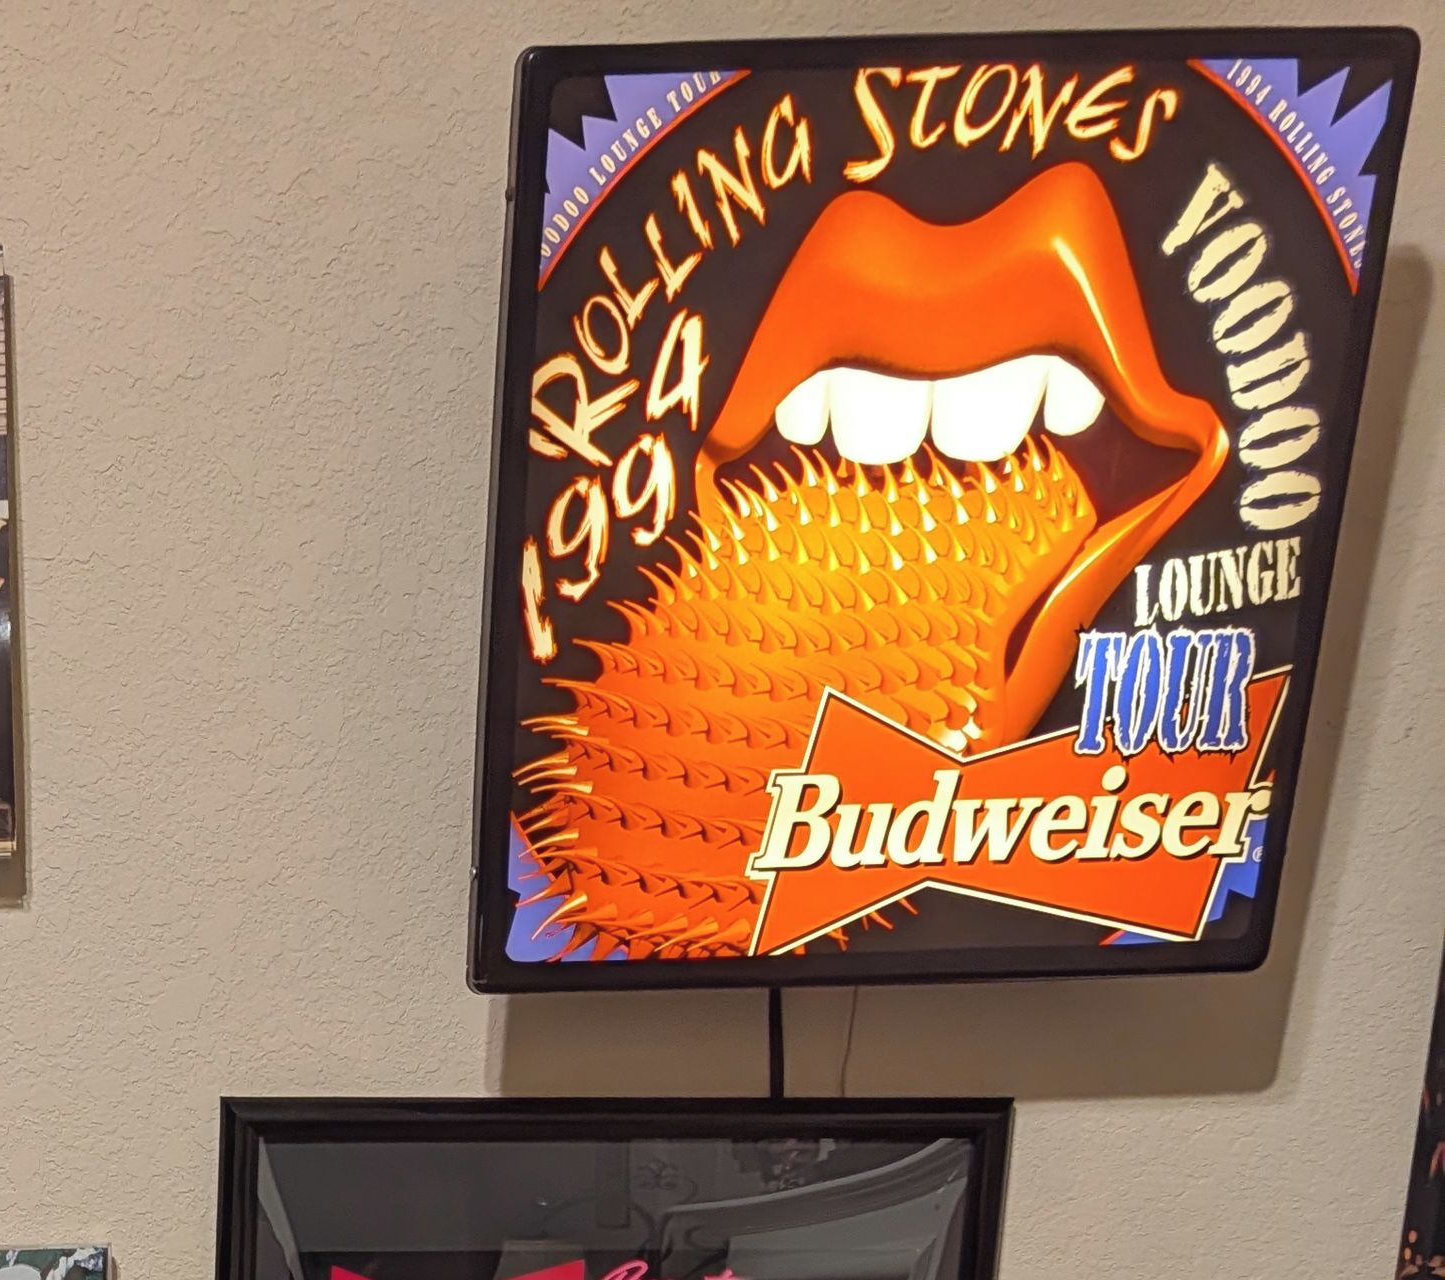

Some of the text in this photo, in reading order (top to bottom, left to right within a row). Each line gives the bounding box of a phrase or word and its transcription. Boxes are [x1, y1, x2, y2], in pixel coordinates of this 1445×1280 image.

[589, 107, 662, 186] LOUNGE
[1227, 58, 1272, 106] 1994
[1269, 99, 1336, 185] ROLLING
[525, 63, 1178, 467] ROLLING STONES
[1161, 162, 1322, 532] VOODOO
[520, 308, 710, 664] 1994
[1133, 536, 1302, 627] LOUNGE
[1074, 626, 1256, 757] TOUR
[753, 765, 1272, 871] Budweiser
